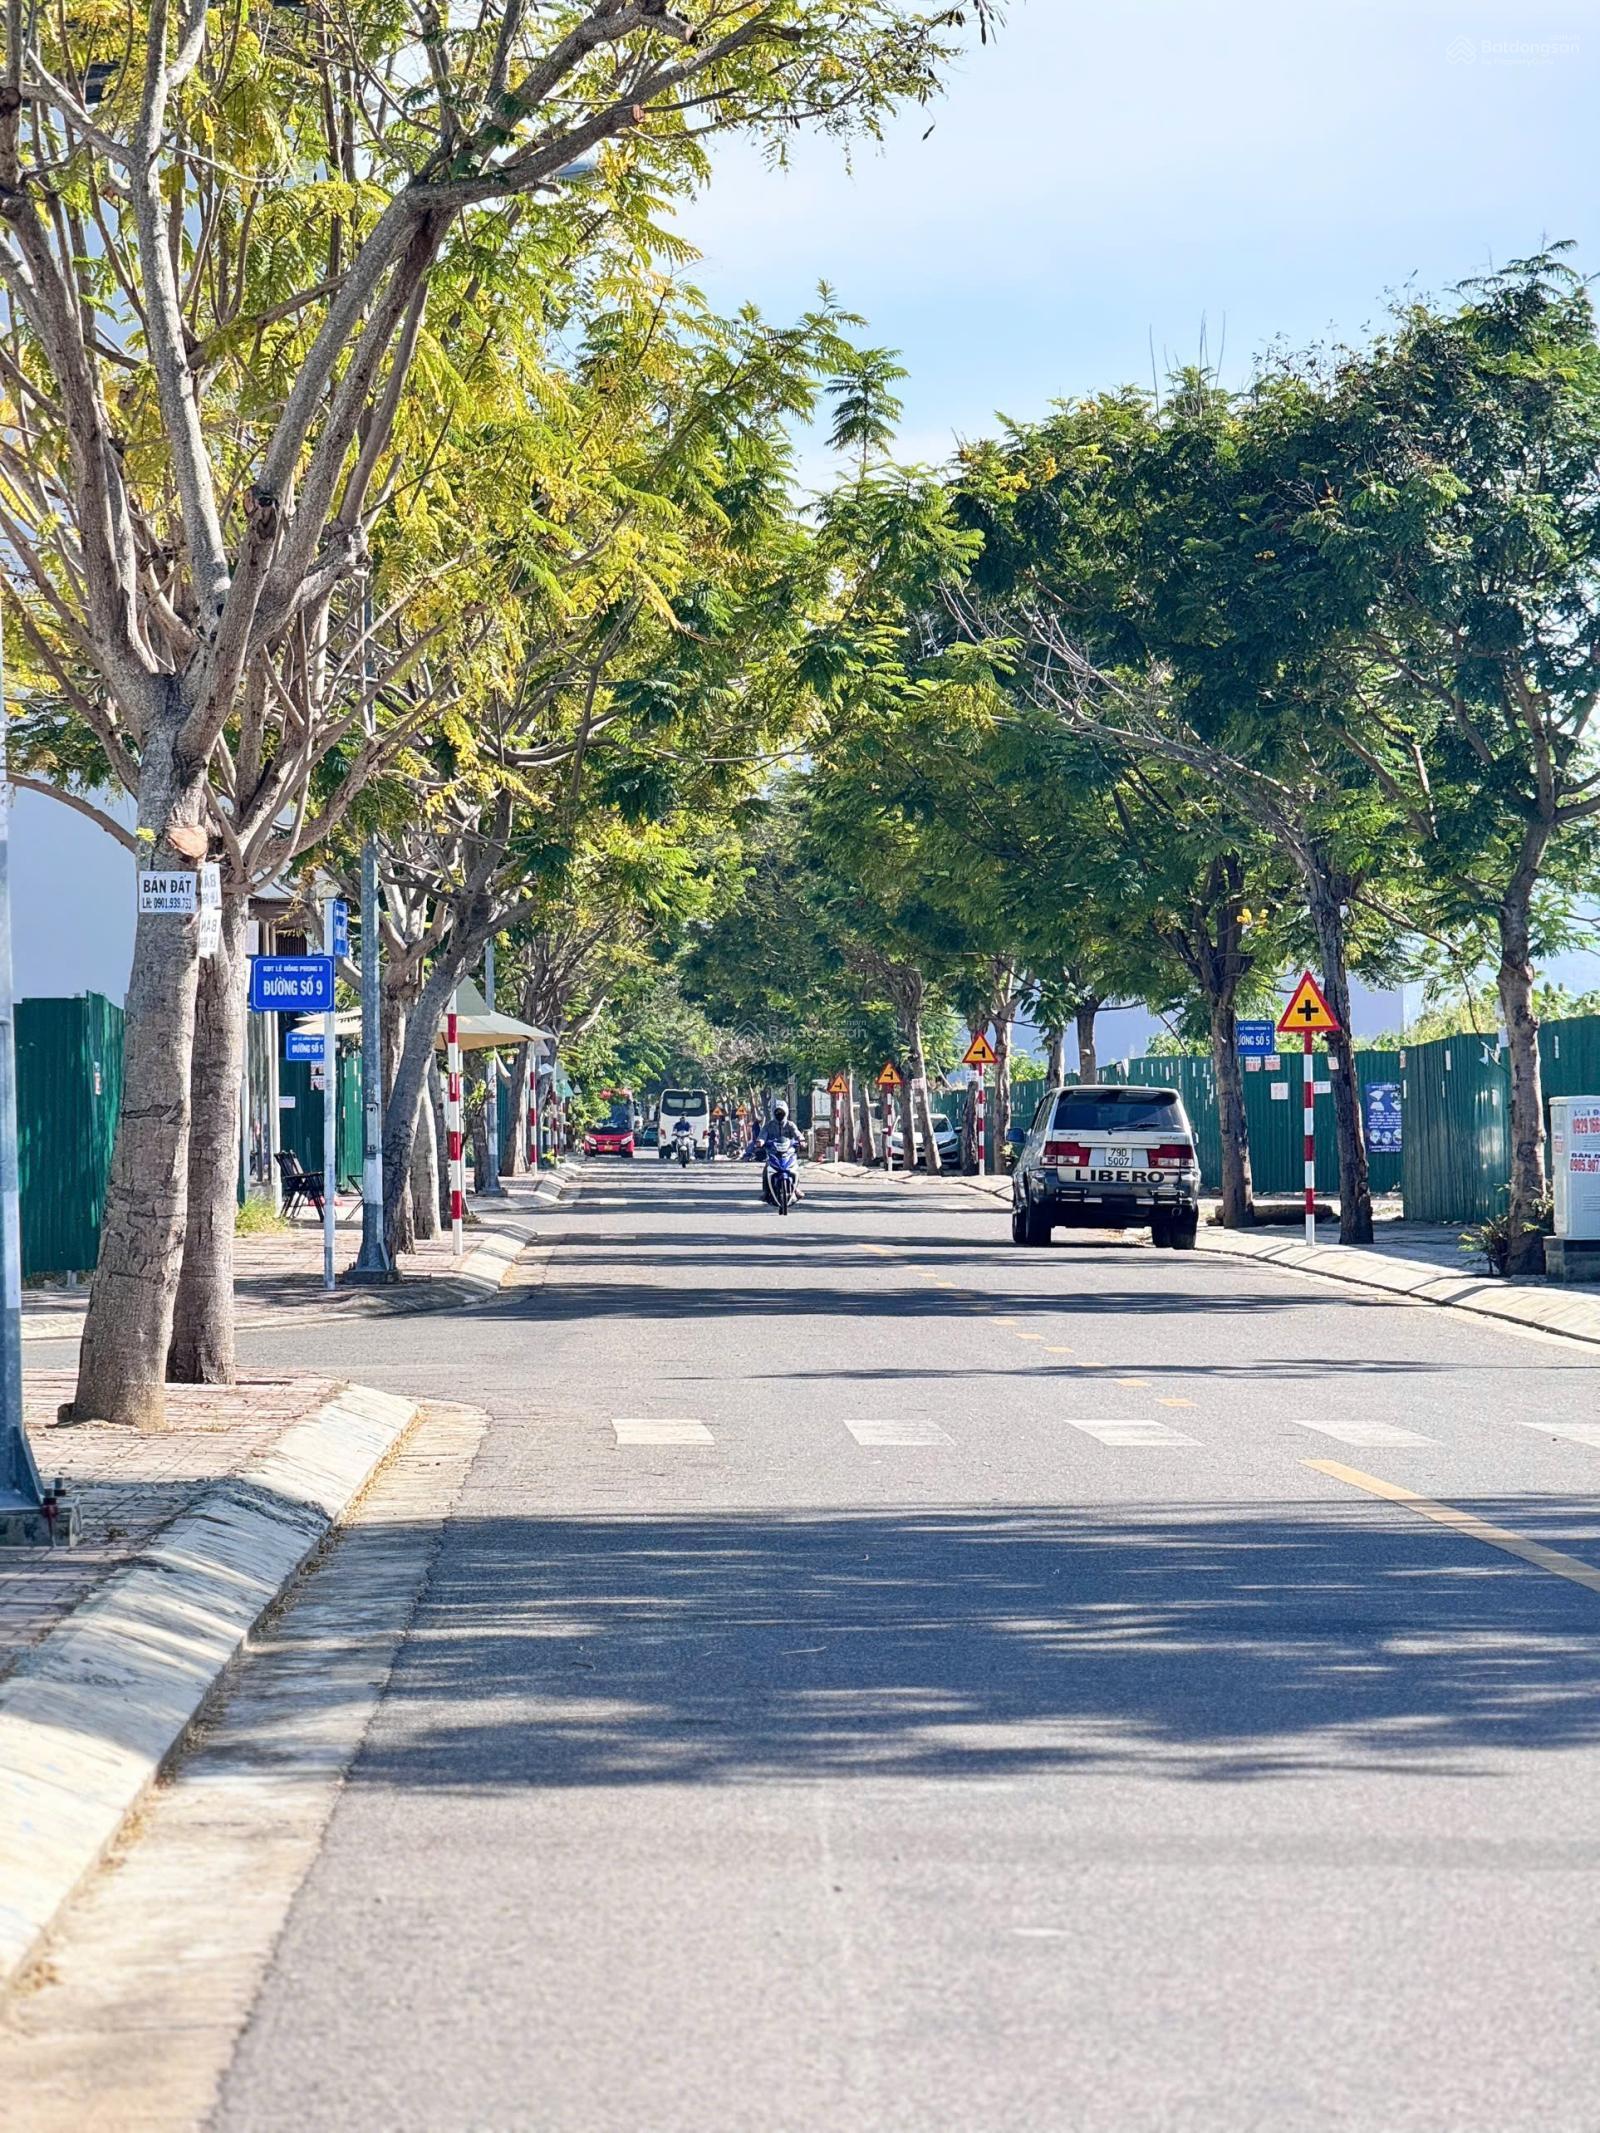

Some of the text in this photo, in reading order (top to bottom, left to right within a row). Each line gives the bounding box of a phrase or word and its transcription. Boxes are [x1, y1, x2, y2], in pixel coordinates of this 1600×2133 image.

[144, 875, 191, 893] BÁN ĐẤT
[263, 975, 323, 996] ĐƯỜNG SỐ 9
[1256, 1031, 1264, 1046] SỐ
[1265, 1035, 1270, 1046] 5
[1111, 1148, 1126, 1157] 79D
[1108, 1157, 1130, 1166] 5007
[1075, 1169, 1164, 1183] LIBERO
